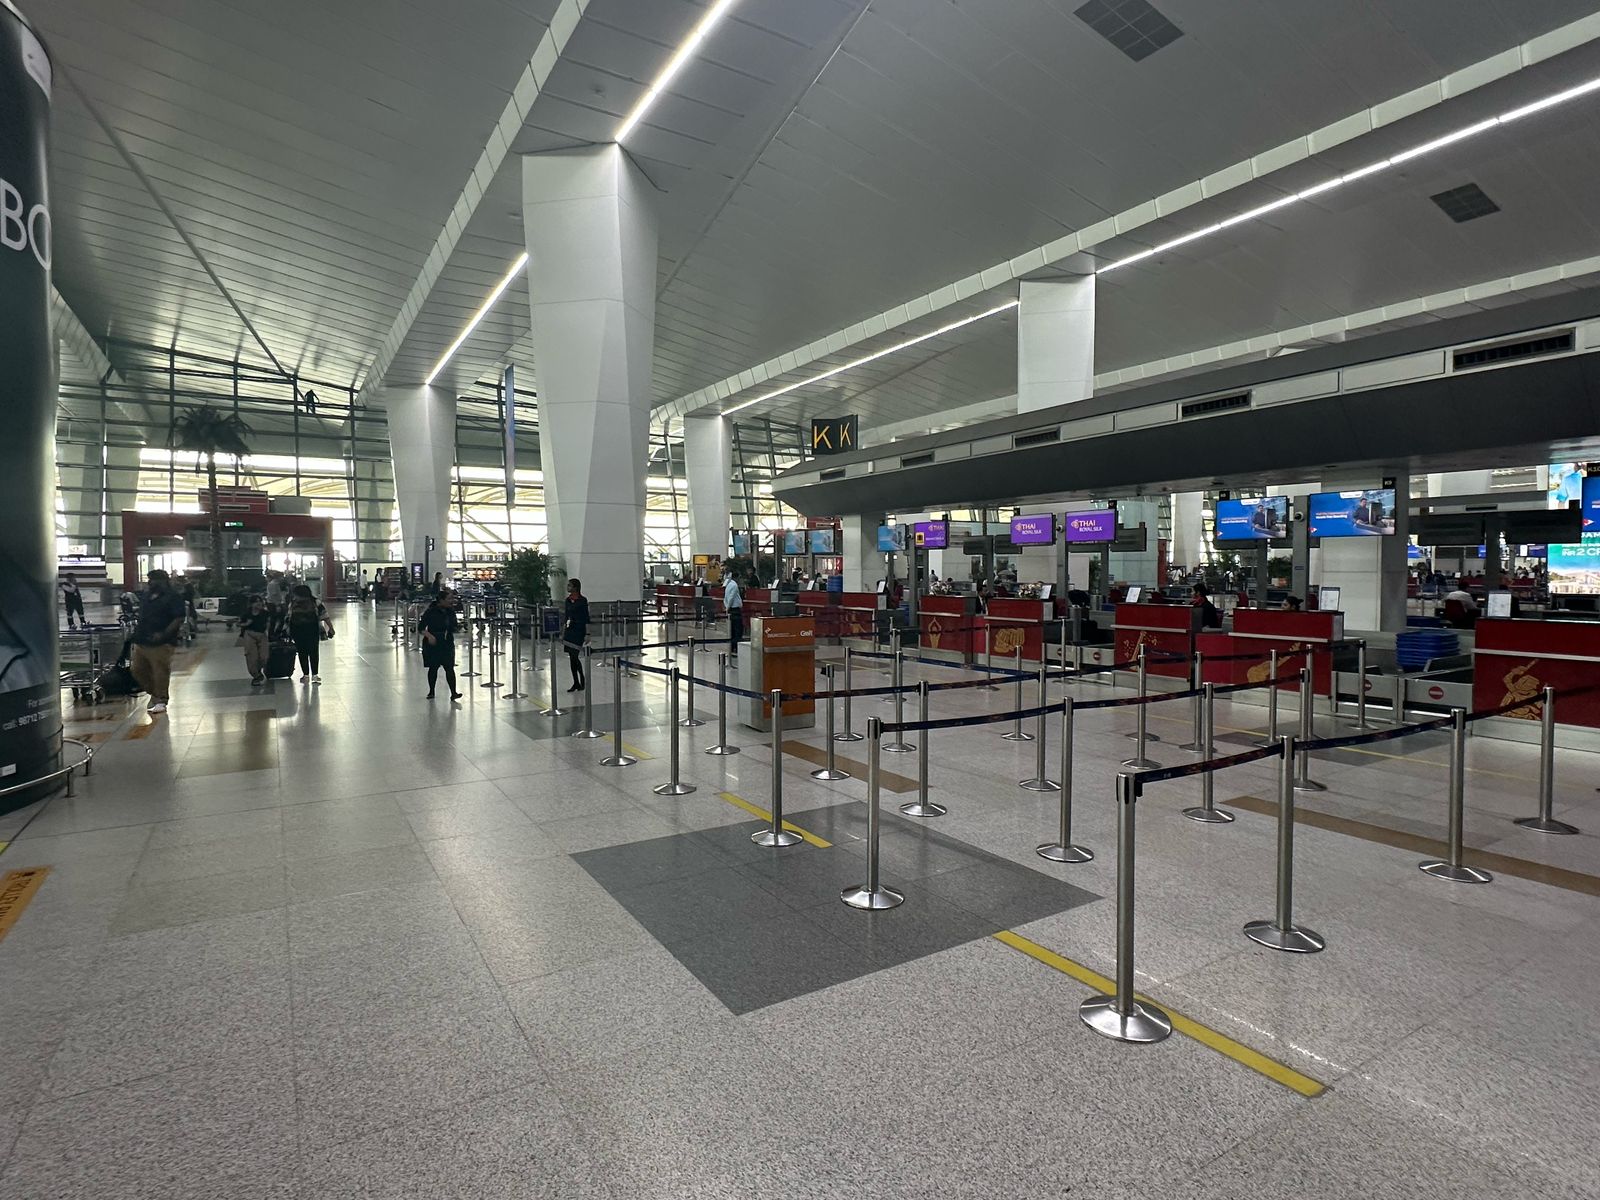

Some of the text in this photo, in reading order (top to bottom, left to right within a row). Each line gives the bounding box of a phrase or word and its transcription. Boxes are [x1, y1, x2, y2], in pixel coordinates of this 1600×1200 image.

[813, 425, 832, 449] K
[840, 422, 851, 448] K
[1021, 522, 1036, 530] THAI
[1079, 519, 1096, 527] THAI
[1576, 547, 1585, 556] 2
